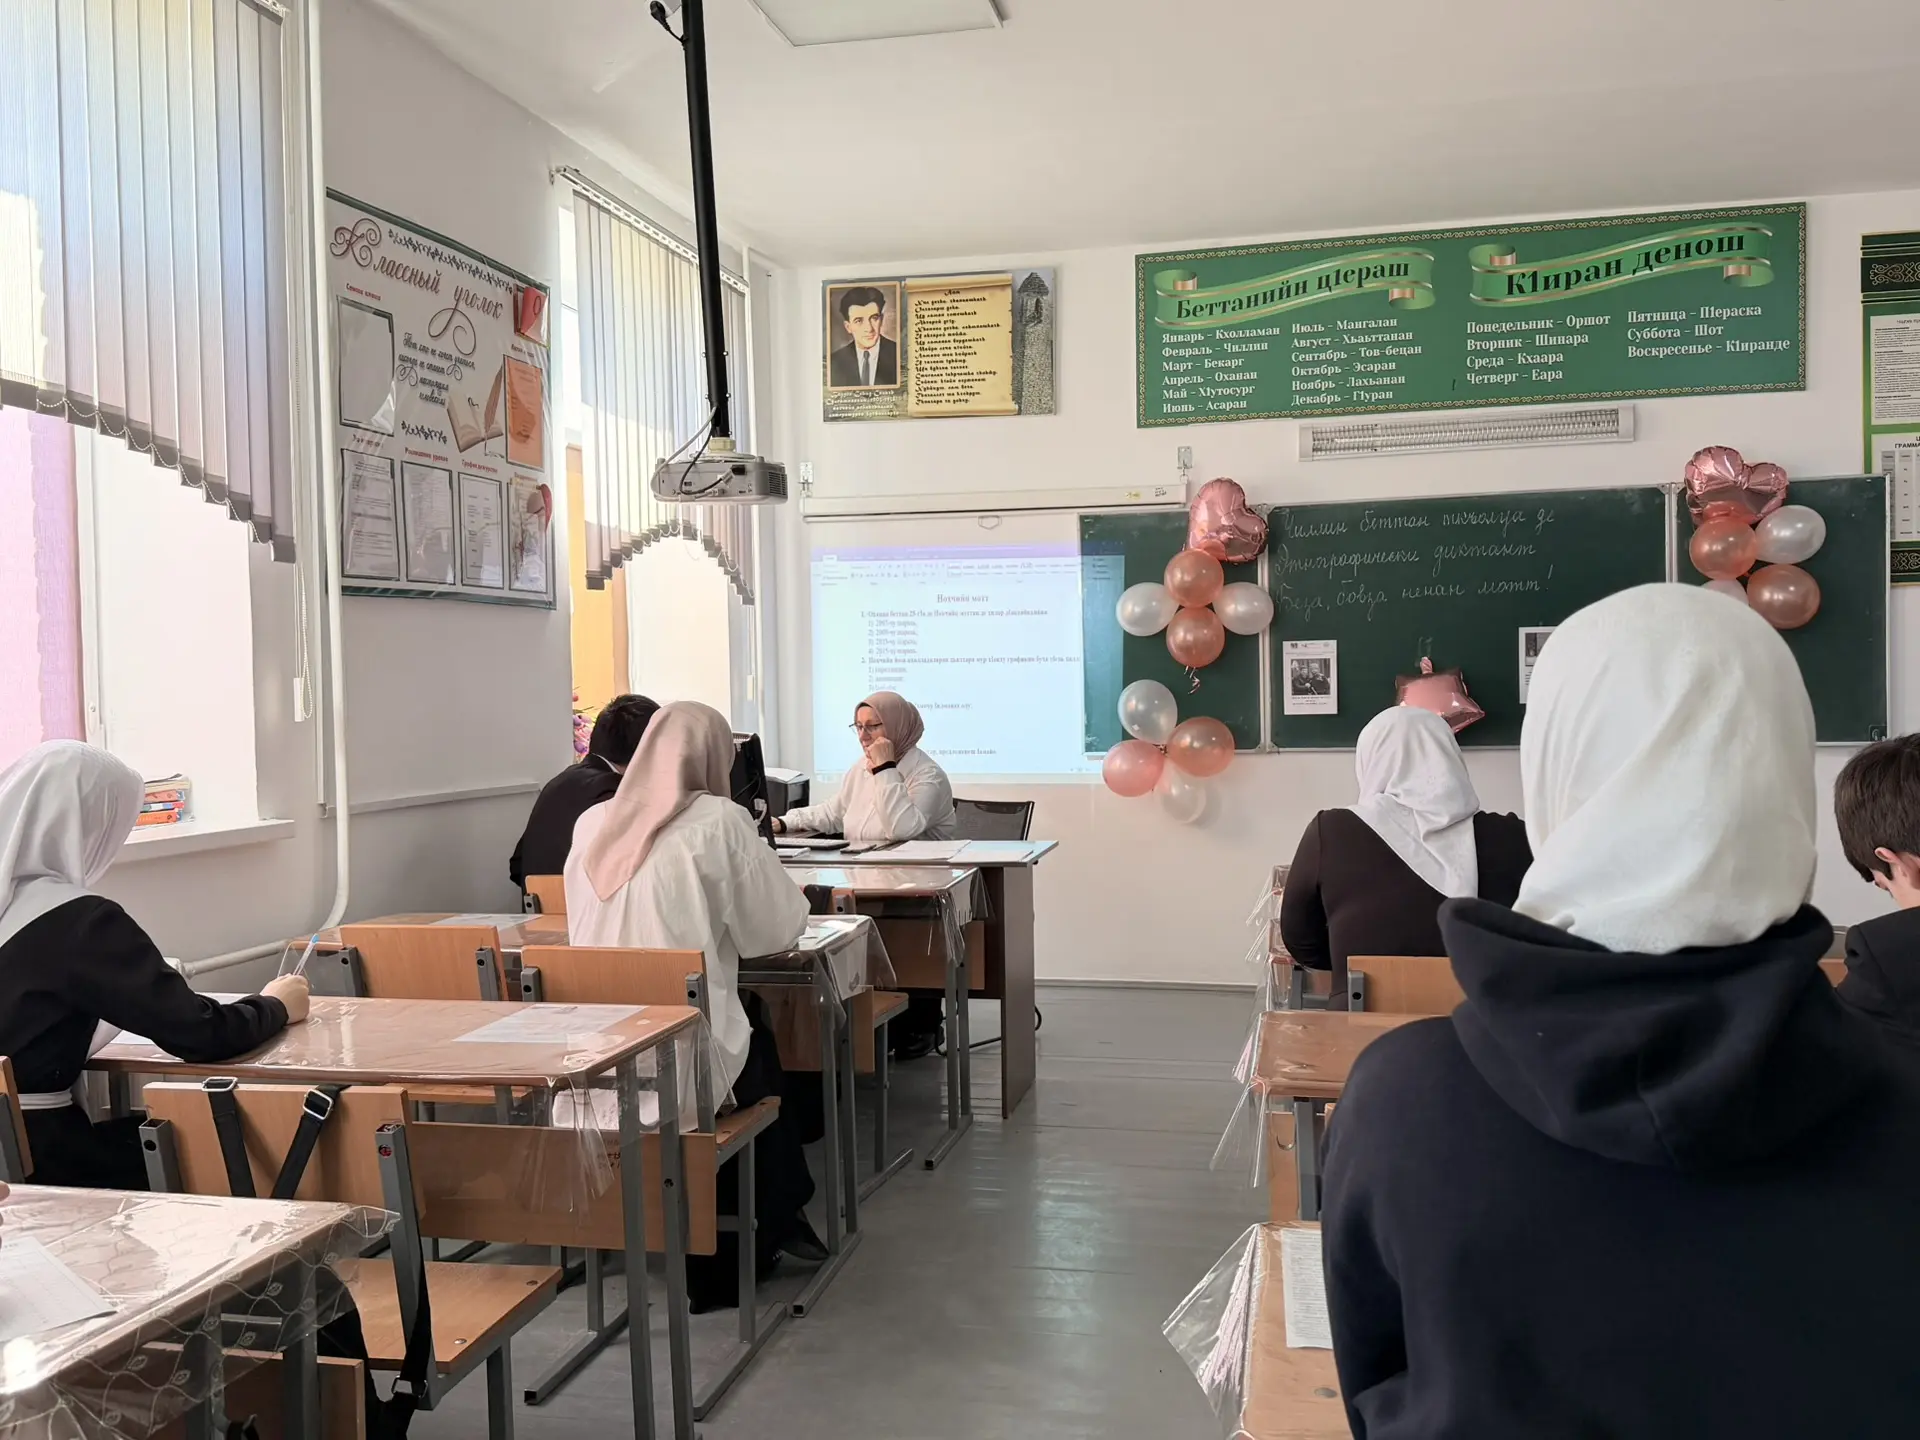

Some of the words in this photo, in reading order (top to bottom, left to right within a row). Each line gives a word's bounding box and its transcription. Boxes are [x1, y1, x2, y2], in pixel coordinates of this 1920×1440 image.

[1632, 234, 1744, 275] денош
[329, 217, 441, 295] Классный
[428, 285, 504, 356] уголок
[1176, 279, 1308, 319] Беттанийн
[1466, 318, 1553, 334] Понедельник
[1566, 314, 1610, 328] Оршот
[1628, 309, 1686, 324] Пятница
[1292, 323, 1324, 334] Июль
[1336, 318, 1397, 331] Мангалан
[1628, 327, 1680, 341] Суббота
[1695, 324, 1723, 337] Шот
[1162, 332, 1204, 343] Январь
[1215, 326, 1280, 339] Кхолламан
[1467, 337, 1522, 351] Вторник
[1535, 333, 1589, 348] Шинара
[1162, 345, 1212, 358] Февраль
[1224, 341, 1268, 353] Чиллин
[1291, 337, 1331, 349] Август
[1628, 342, 1712, 358] Воскресенье
[1291, 350, 1347, 362] Сентябрь
[1359, 345, 1422, 358] Тов-бецан
[1466, 355, 1504, 368] Среда
[1517, 351, 1564, 366] Кхаара
[1162, 361, 1193, 372] Март
[1204, 356, 1244, 369] Бекарг
[1292, 365, 1341, 377] Октябрь
[1353, 361, 1396, 373] Эсаран
[1162, 374, 1203, 386] Апрель
[1215, 371, 1257, 382] Оханан
[1292, 379, 1335, 391] Ноябрь
[1347, 374, 1405, 388] Лахьанан
[1466, 372, 1519, 385] Четверг
[1532, 369, 1562, 382] Еара
[1162, 388, 1187, 399] Май
[1291, 393, 1341, 406] Декабрь
[1162, 403, 1194, 414] Июнь
[1206, 400, 1246, 411] Асаран
